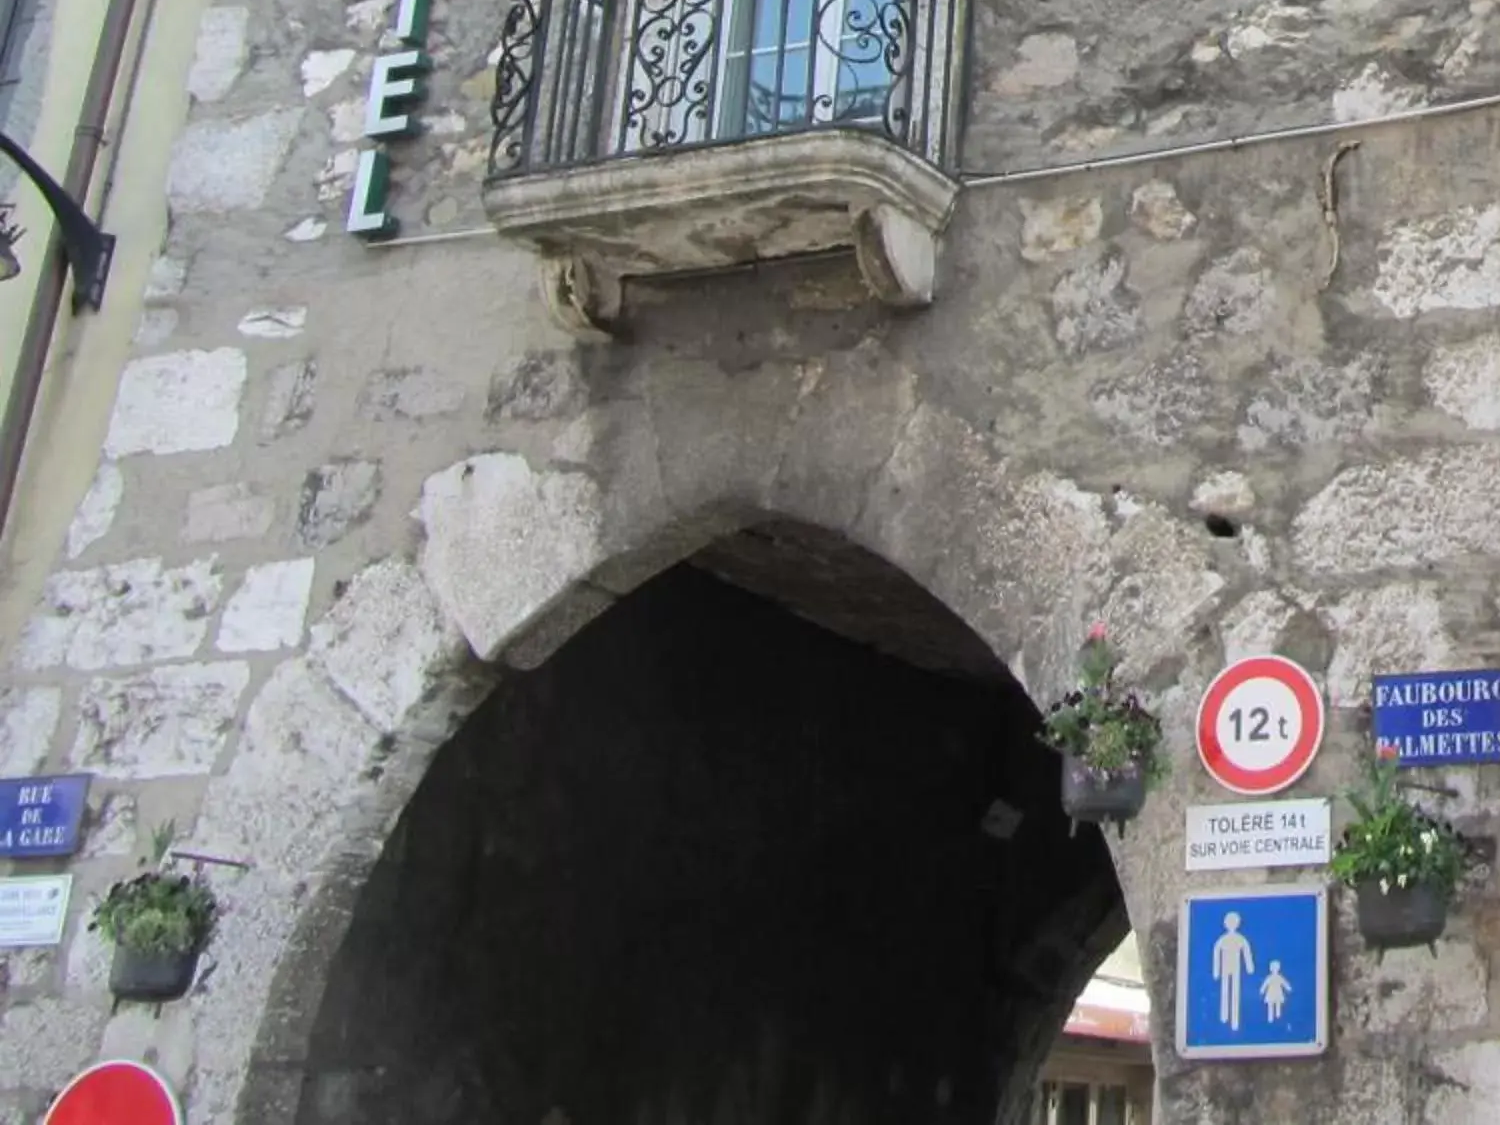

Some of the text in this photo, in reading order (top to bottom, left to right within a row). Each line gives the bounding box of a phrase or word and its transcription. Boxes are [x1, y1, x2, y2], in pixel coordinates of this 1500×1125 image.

[1422, 708, 1463, 728] DES
[18, 786, 53, 805] RUE
[21, 807, 43, 825] DE
[19, 827, 65, 846] GARE
[1189, 834, 1325, 859] SUR VOIE CENTRALE
